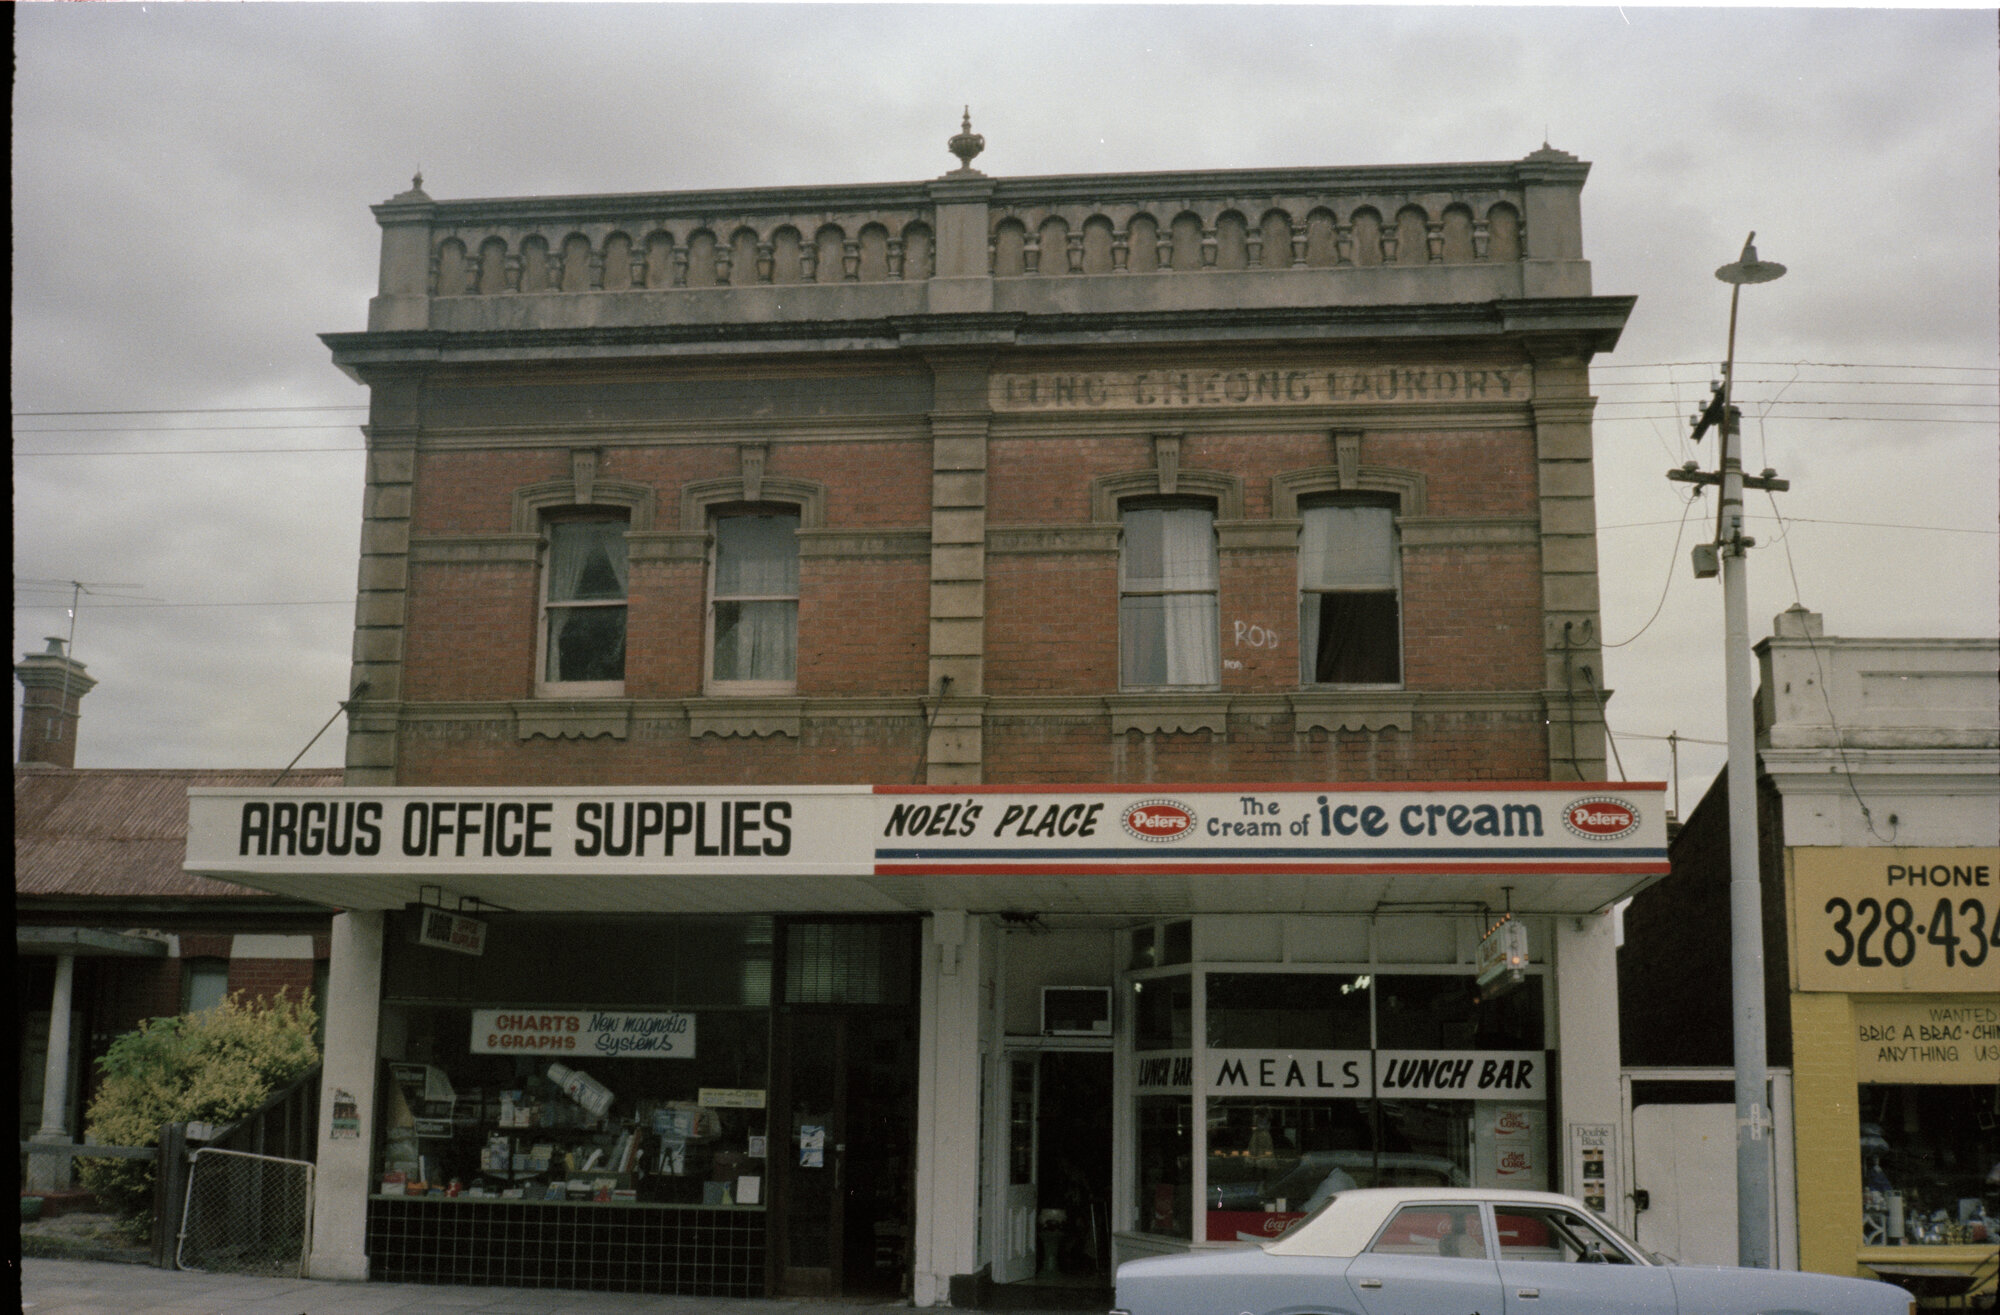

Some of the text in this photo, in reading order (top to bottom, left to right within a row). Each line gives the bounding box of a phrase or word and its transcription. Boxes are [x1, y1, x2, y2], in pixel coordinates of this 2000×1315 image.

[1234, 620, 1279, 649] ROD
[1206, 795, 1545, 837] Cream of ice cream
[1239, 796, 1281, 816] The
[883, 798, 1105, 837] NOEL'S PLACE
[1133, 810, 1188, 829] Peters
[1573, 808, 1631, 828] Peters
[239, 801, 792, 857] ARGUS OFFICE SUPPLIES
[1887, 865, 1990, 887] PHONE
[495, 1014, 580, 1033] CHARTS
[587, 1012, 687, 1037] New magnetic
[1929, 1008, 1998, 1023] WANTED
[595, 1033, 674, 1056] Systems
[1859, 1025, 1896, 1042] BRIC
[1903, 1025, 1915, 1040] A
[1878, 1046, 1959, 1062] ANYTHING
[1138, 1058, 1171, 1086] LUNCH
[1215, 1059, 1361, 1089] MEALS
[1382, 1058, 1534, 1090] LUNCH BAR
[1576, 1127, 1609, 1137] Double
[1581, 1136, 1606, 1146] Black
